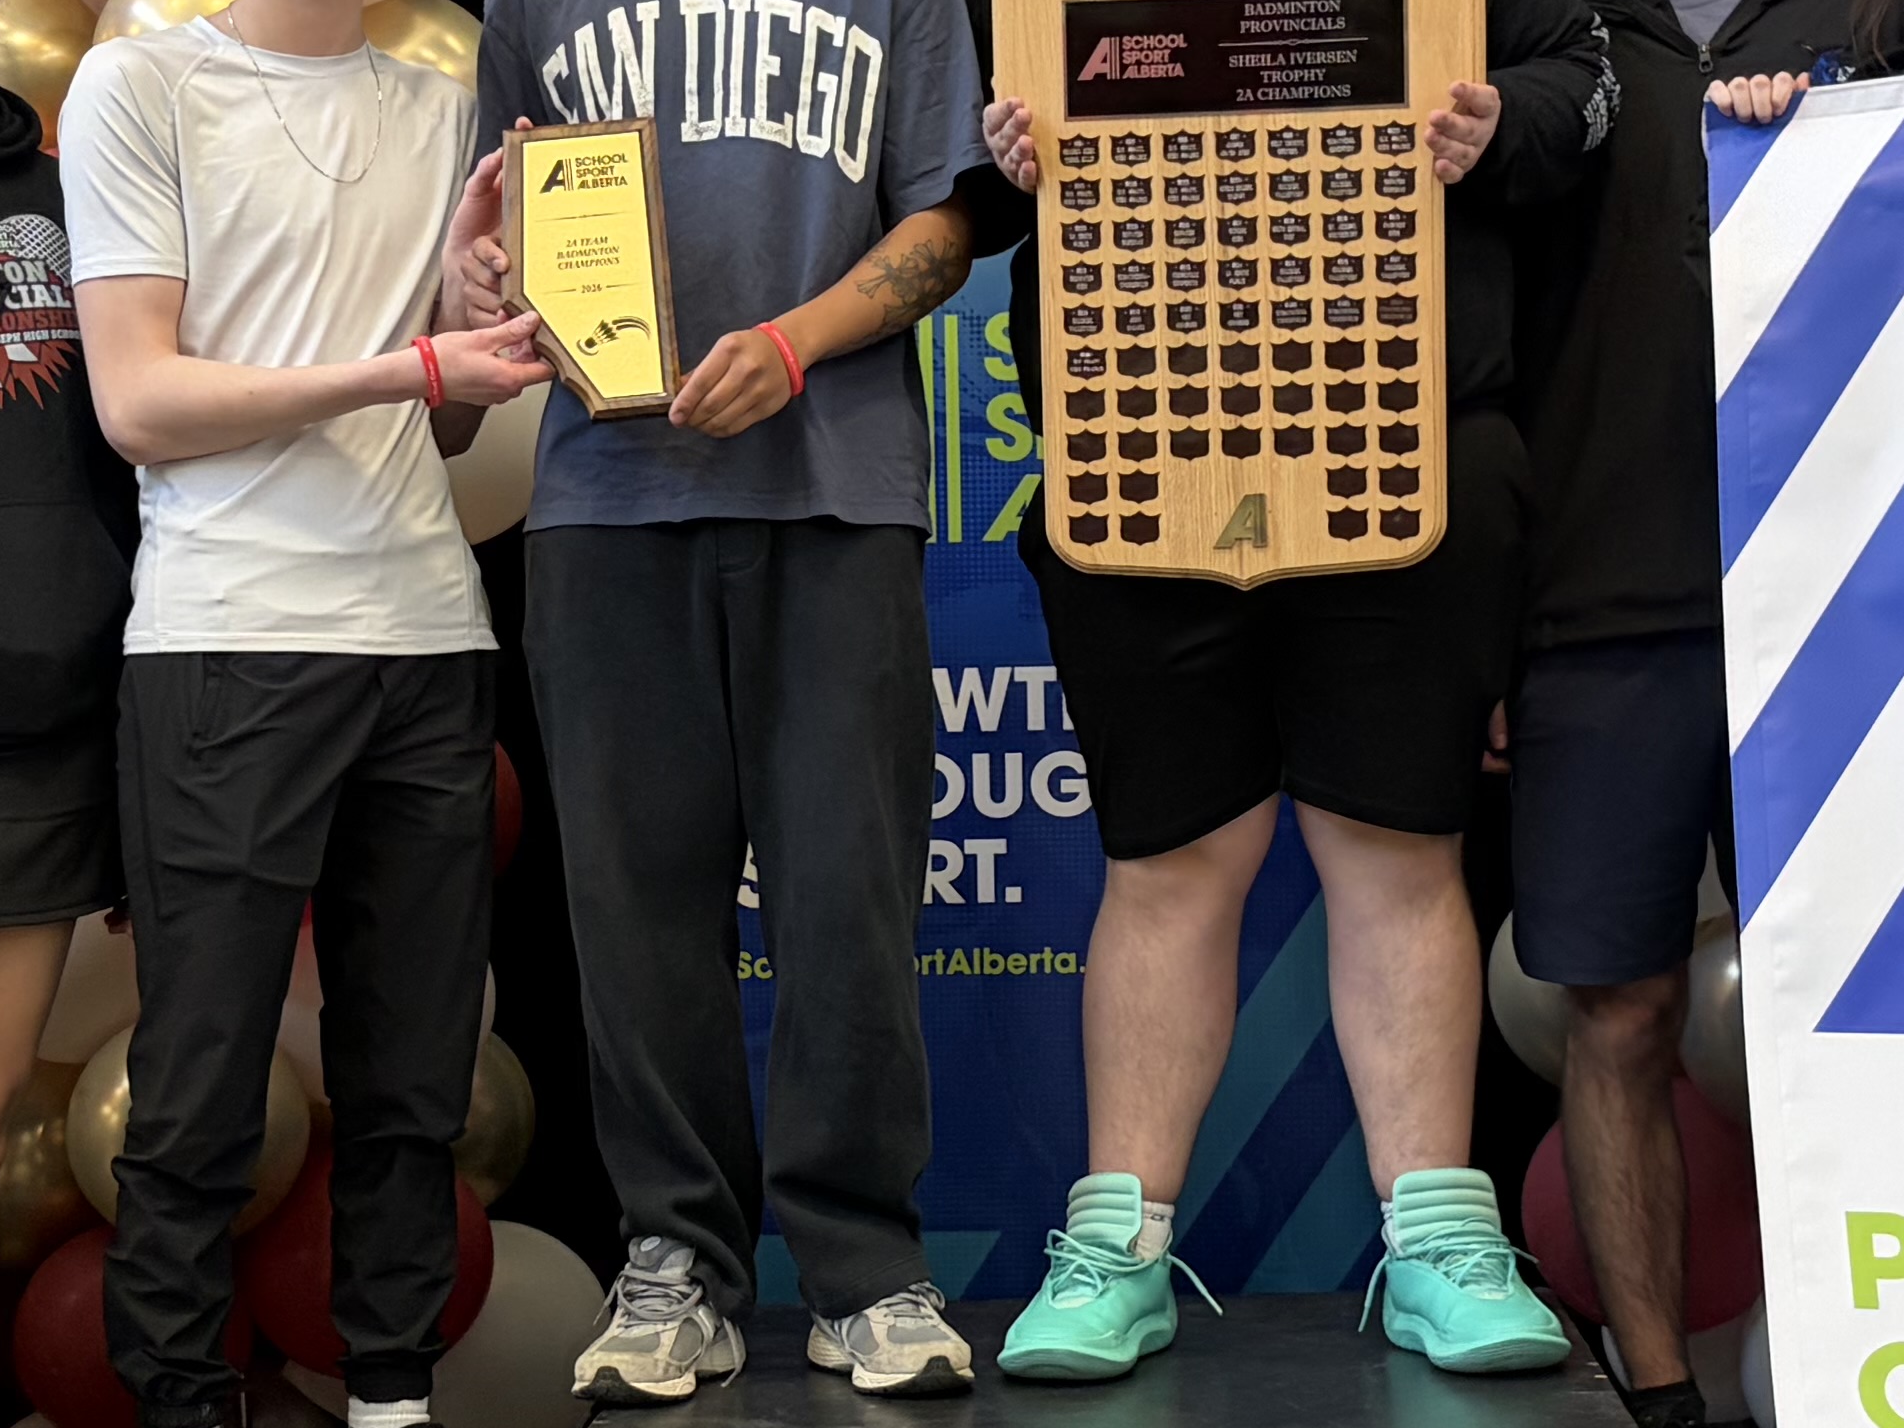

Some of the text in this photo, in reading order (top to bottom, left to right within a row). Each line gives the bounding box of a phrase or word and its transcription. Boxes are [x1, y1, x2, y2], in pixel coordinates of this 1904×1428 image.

[1244, 0, 1342, 17] BADMINTON
[1239, 16, 1346, 34] PROVINCIALS
[1122, 33, 1188, 50] SCHOOL
[1122, 49, 1170, 64] SPORT
[1228, 49, 1358, 68] SHEILA IVERSEN
[1122, 63, 1185, 79] ALBERTA
[1260, 68, 1327, 84] TROPHY
[1236, 84, 1351, 102] 2A CHAMPIONS
[575, 153, 628, 167] SCHOOL
[576, 165, 615, 178] SPORT
[577, 176, 628, 190] ALBERTA
[580, 236, 608, 247] TEAM
[556, 246, 620, 260] BADMINTON
[557, 256, 620, 270] CHAMPIONS
